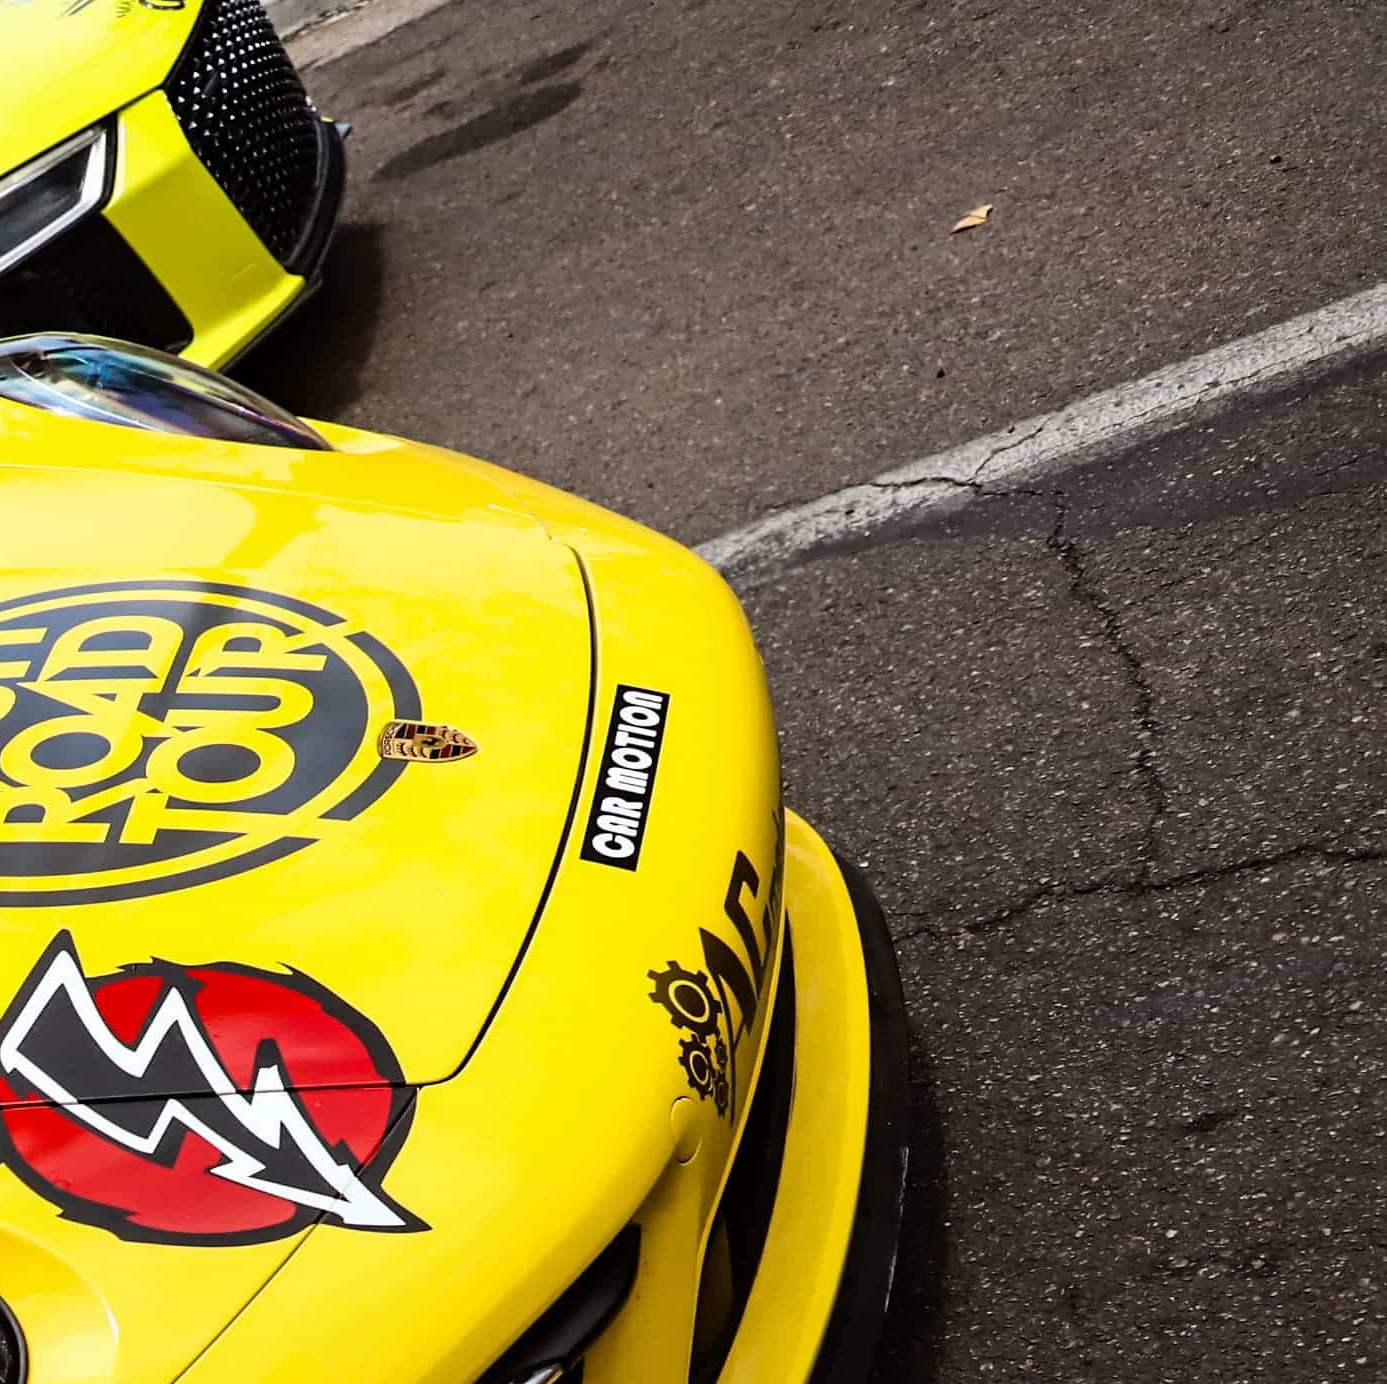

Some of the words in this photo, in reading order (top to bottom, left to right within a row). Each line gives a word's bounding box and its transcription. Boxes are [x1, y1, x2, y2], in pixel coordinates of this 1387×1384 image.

[120, 621, 356, 848] TOUR
[604, 690, 664, 795] MOTION
[591, 796, 644, 859] CAR
